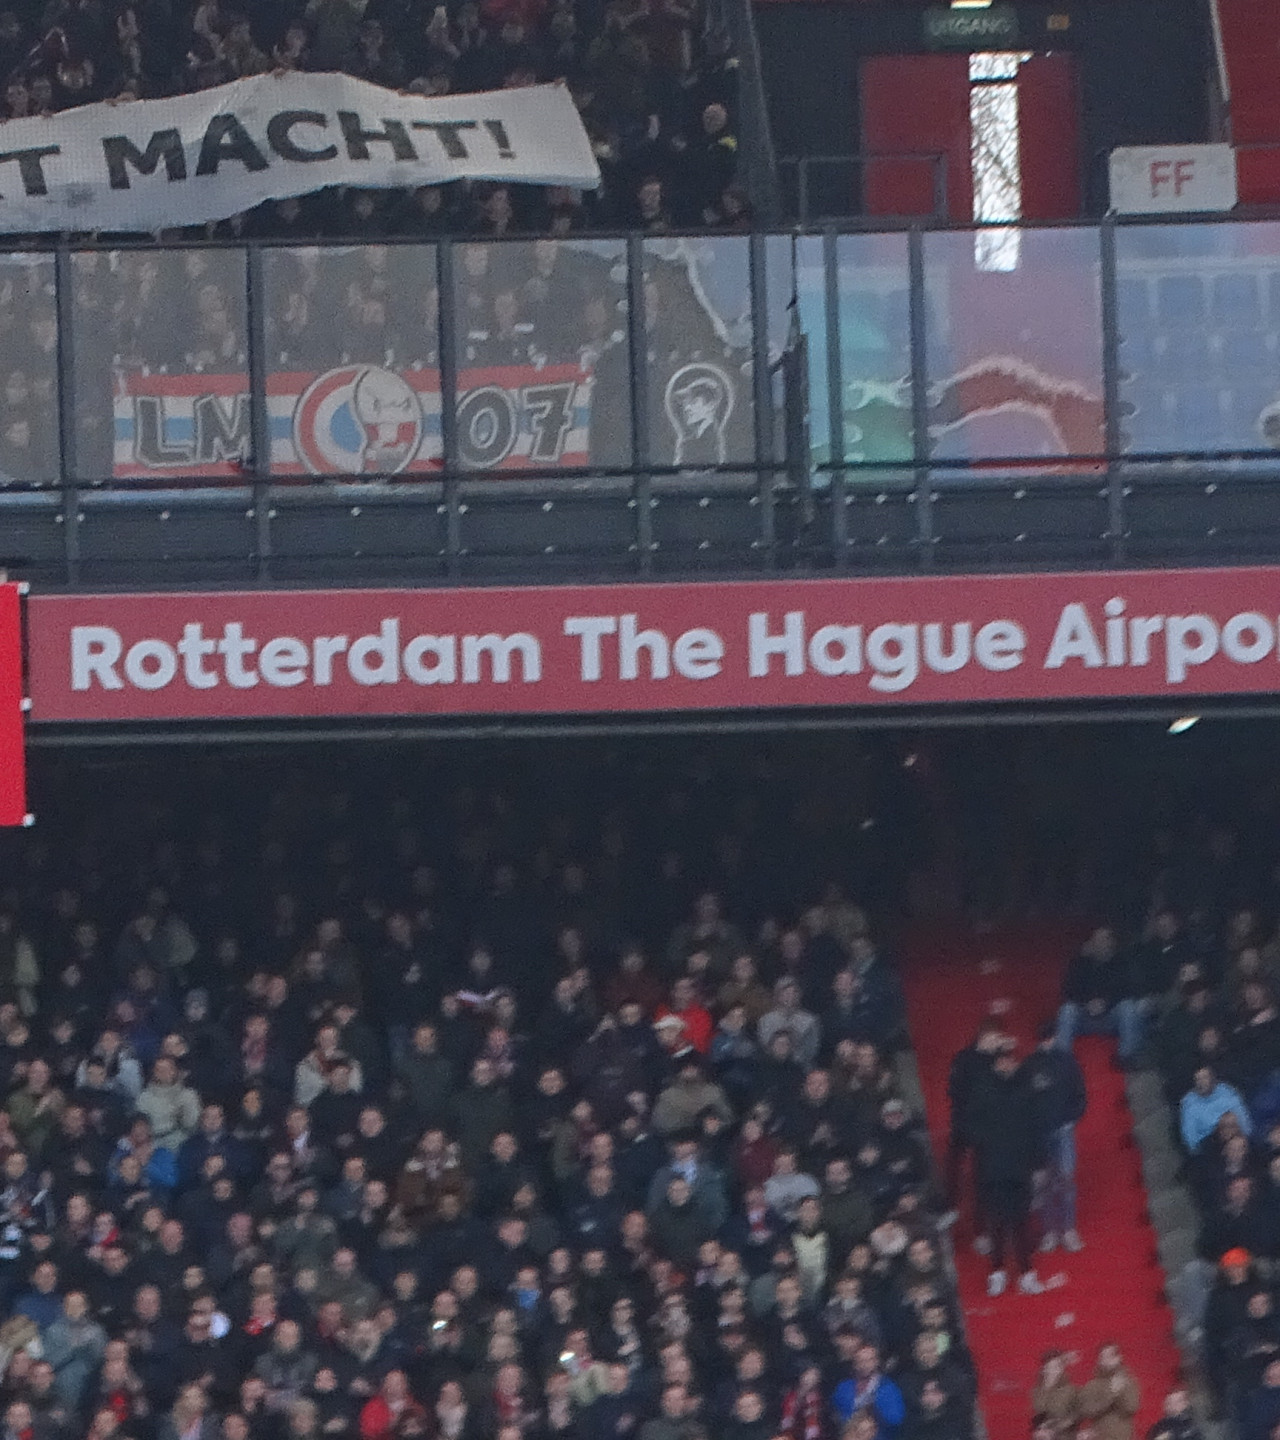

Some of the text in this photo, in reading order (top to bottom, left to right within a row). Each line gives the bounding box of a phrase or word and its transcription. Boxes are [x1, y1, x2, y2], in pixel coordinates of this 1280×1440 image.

[102, 110, 517, 190] MACHT!
[1150, 160, 1195, 198] FF
[70, 596, 1280, 693] Rotterdam The Hague Airpo
